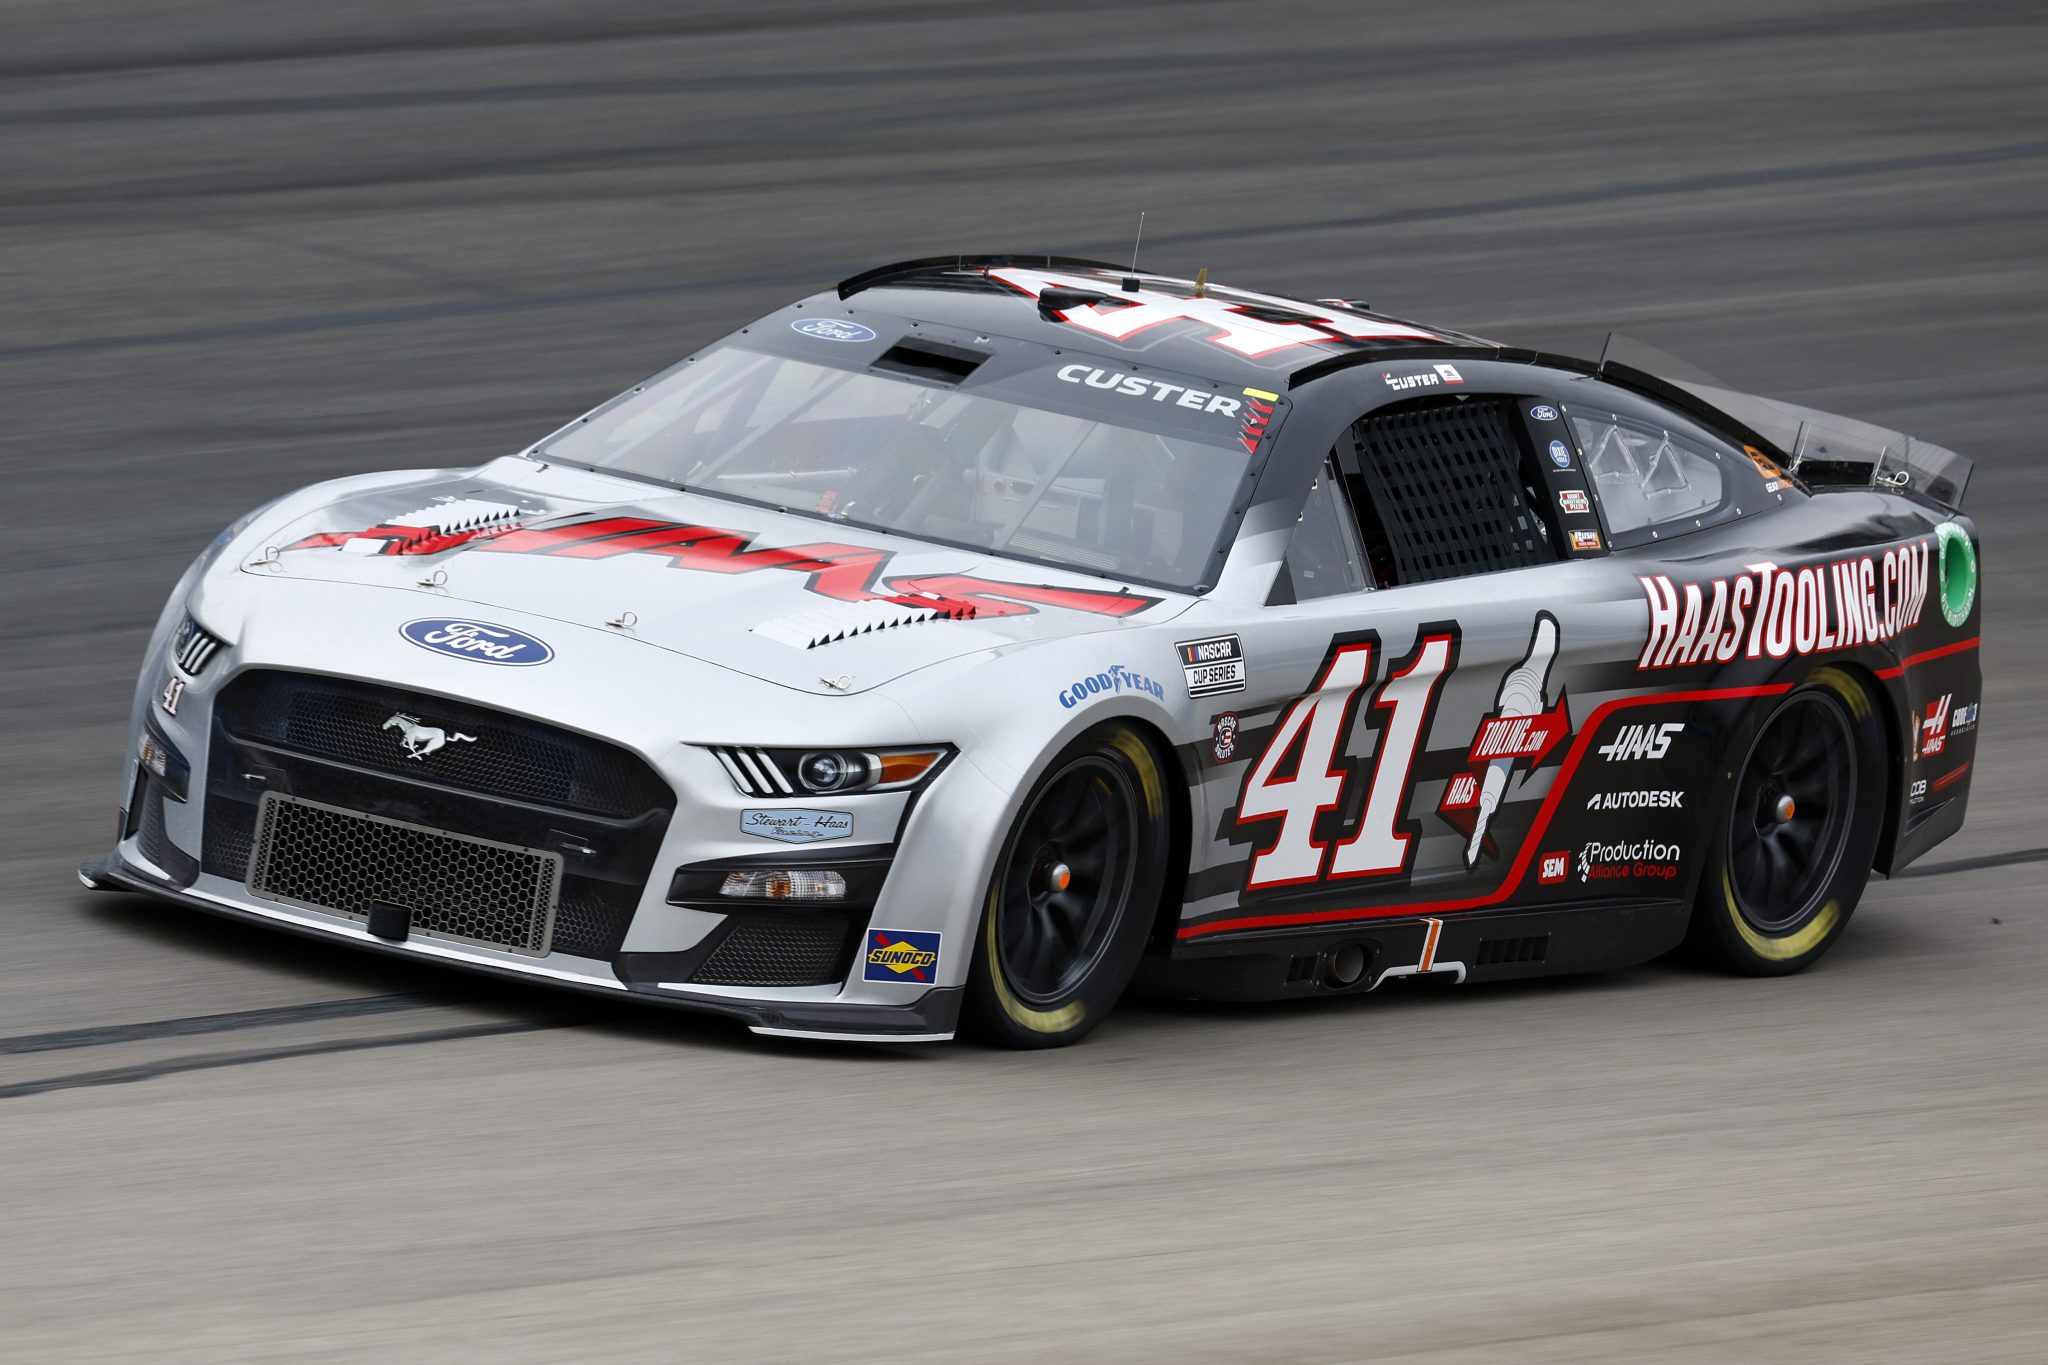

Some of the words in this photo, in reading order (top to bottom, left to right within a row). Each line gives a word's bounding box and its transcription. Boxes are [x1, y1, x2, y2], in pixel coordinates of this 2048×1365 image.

[802, 320, 864, 340] Ford
[1056, 364, 1242, 418] CUSTER
[1385, 373, 1439, 391] CUSTER
[424, 622, 526, 661] Ford
[1198, 641, 1232, 660] NASCAR
[1193, 669, 1208, 684] CUP
[1208, 664, 1236, 683] SERIES
[162, 676, 186, 718] 41
[1059, 670, 1165, 709] GOODYEAR
[1217, 715, 1236, 732] NASCAR
[1598, 723, 1686, 762] HAAS
[1236, 633, 1453, 892] 41
[1446, 777, 1477, 805] HAAS
[1602, 790, 1685, 810] AUTODESK
[1590, 839, 1681, 863] Production
[1542, 857, 1565, 879] SEM
[1589, 864, 1630, 880] Alliance
[1633, 861, 1678, 880] Group
[869, 949, 935, 966] SUNOCO
